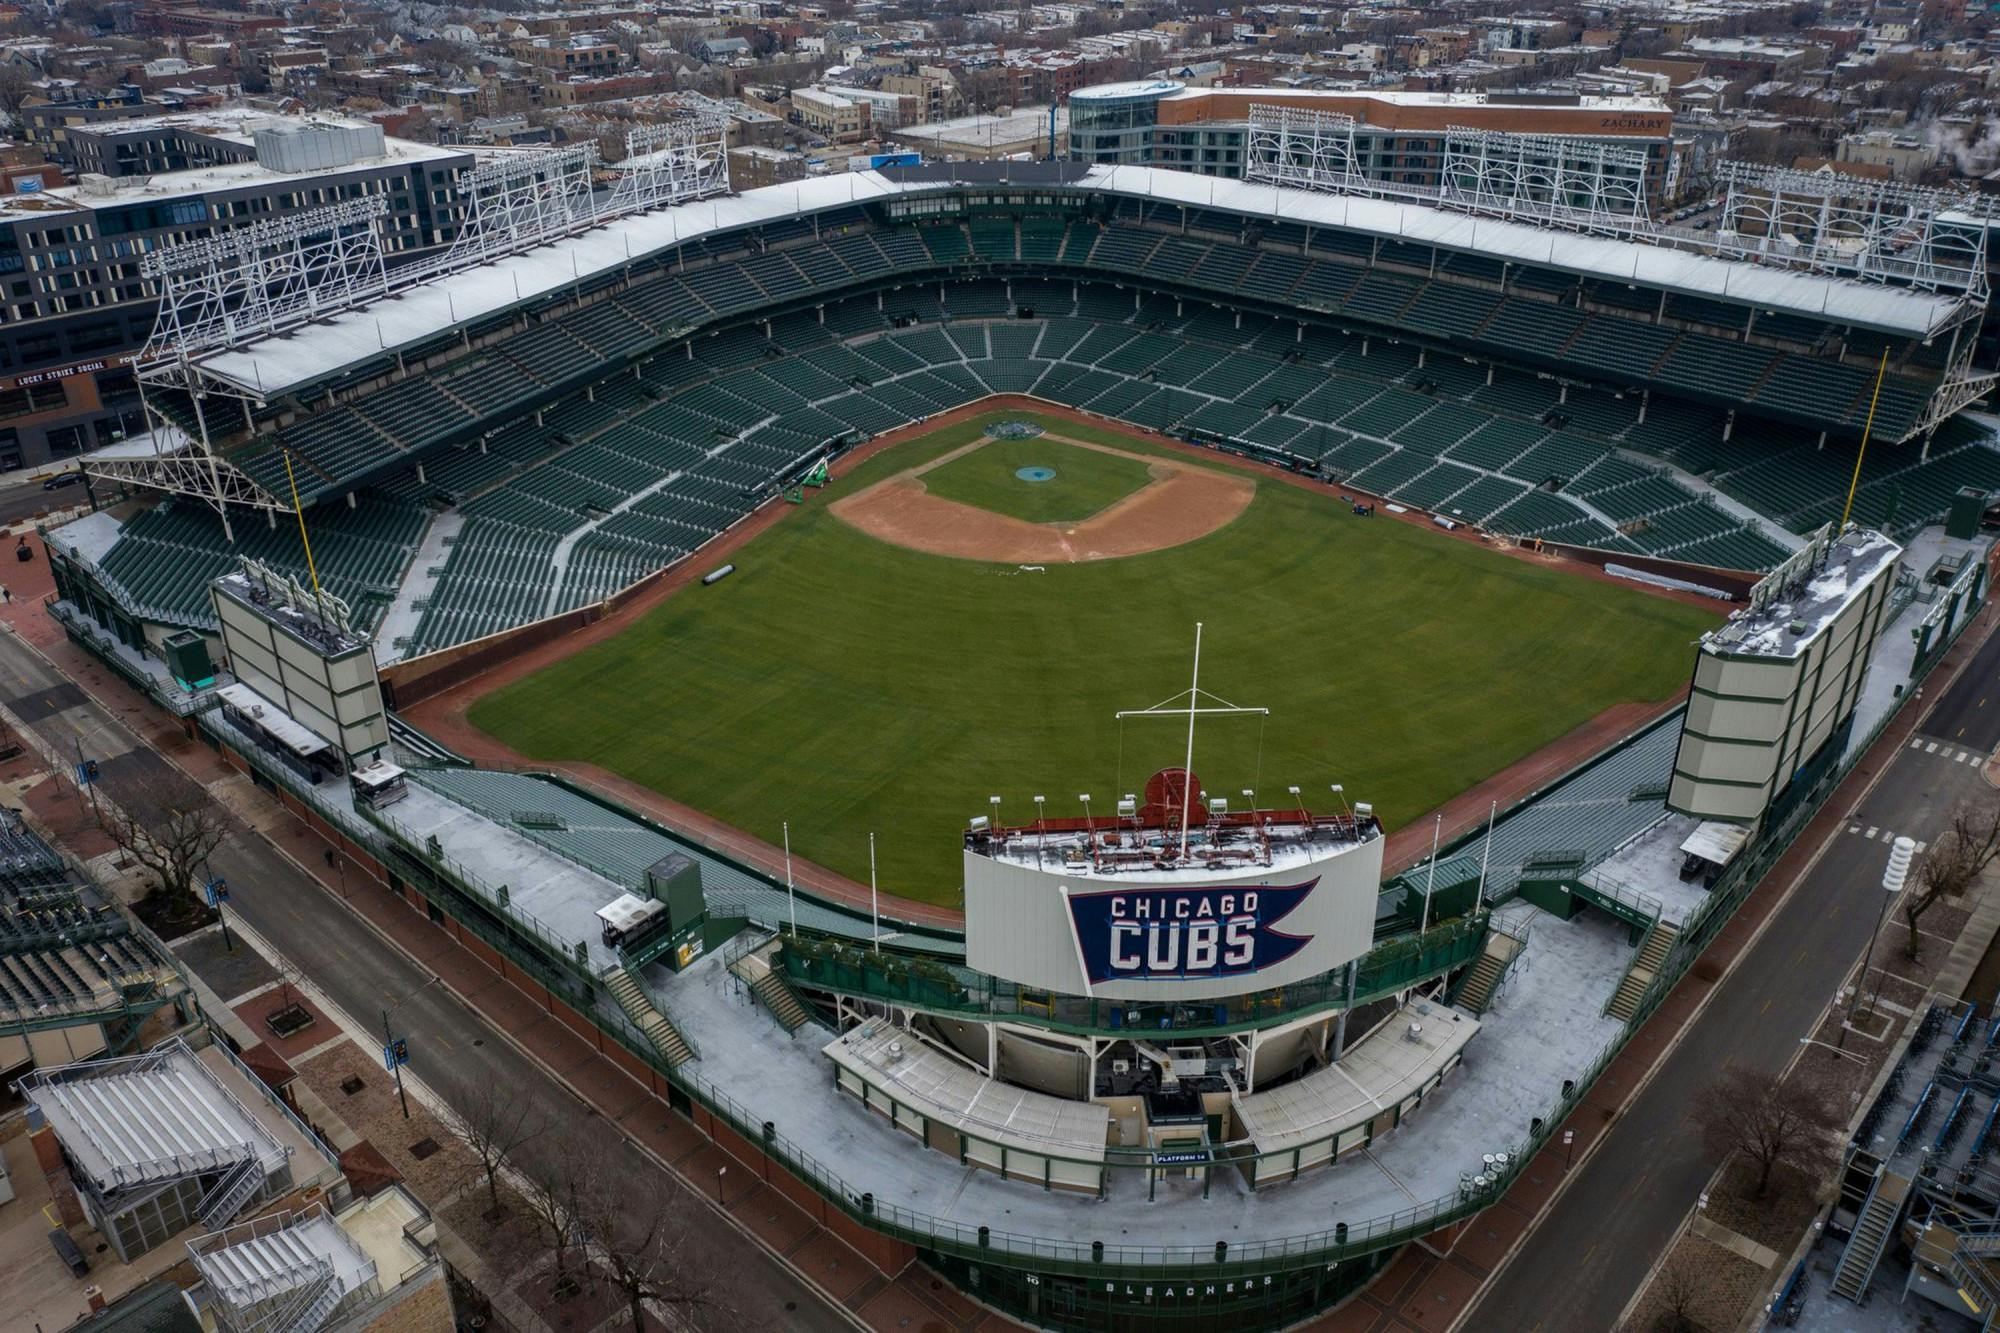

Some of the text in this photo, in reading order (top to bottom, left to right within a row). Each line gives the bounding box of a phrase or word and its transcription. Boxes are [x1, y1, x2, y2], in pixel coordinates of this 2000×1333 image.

[1601, 119, 1665, 128] ZACHARY
[18, 361, 104, 386] LUCKY STRIKE SOCIAL
[1111, 892, 1258, 918] CHICAGO
[1110, 915, 1256, 970] CUBS
[1158, 1154, 1196, 1162] PLATFORM
[1106, 1275, 1272, 1297] BLEACHERS
